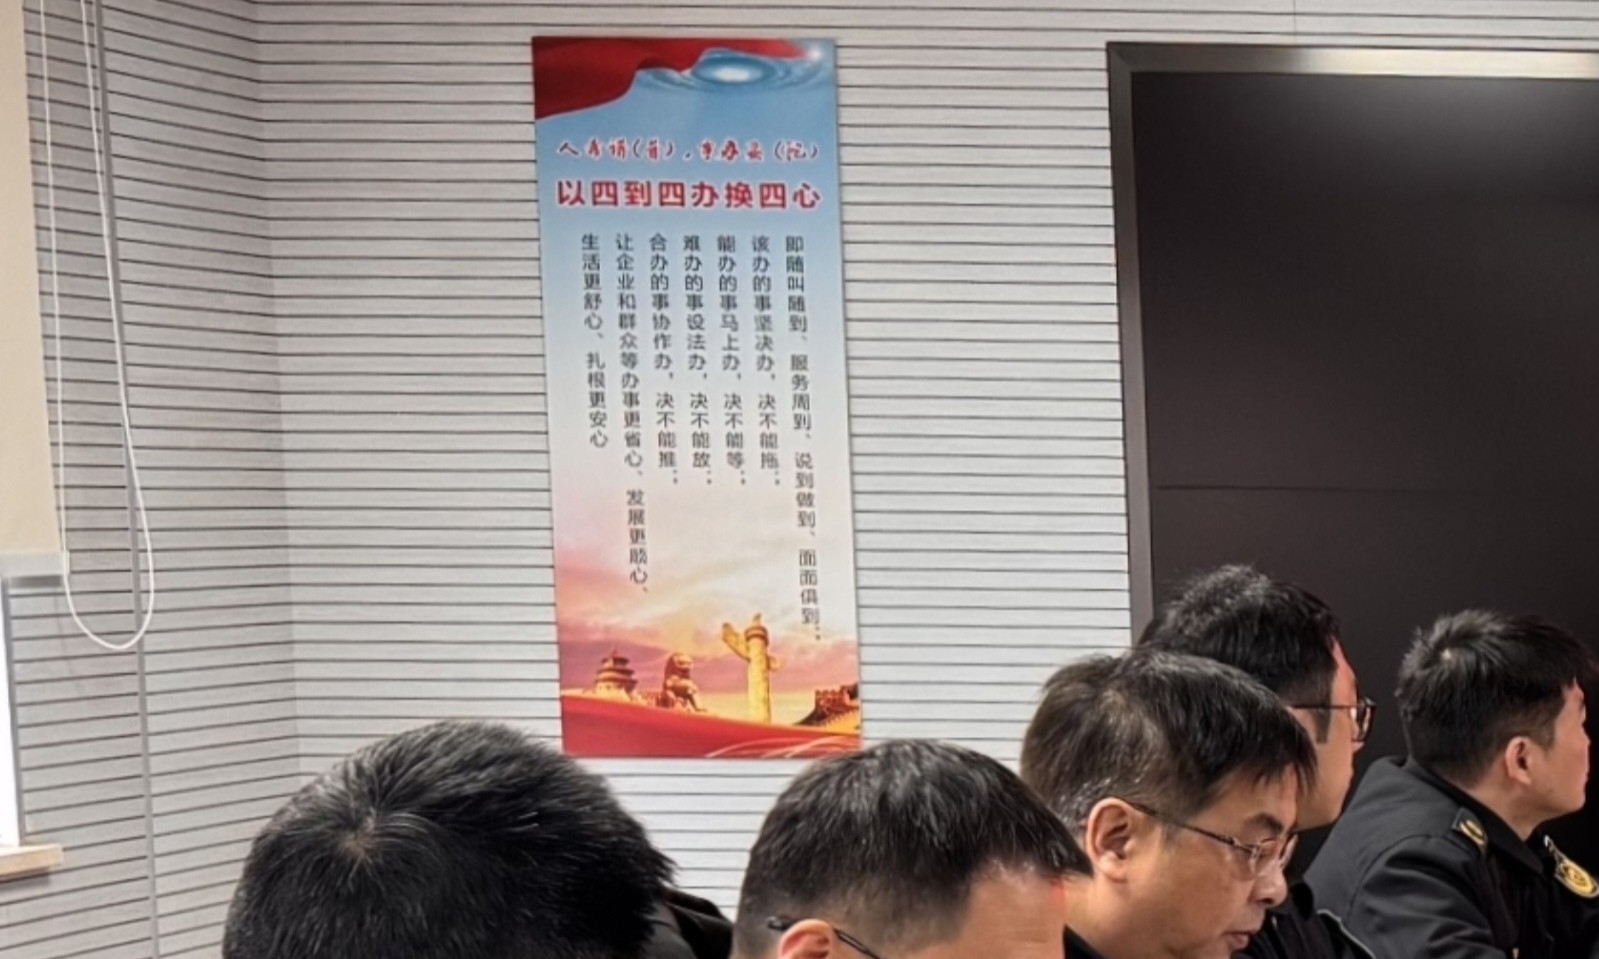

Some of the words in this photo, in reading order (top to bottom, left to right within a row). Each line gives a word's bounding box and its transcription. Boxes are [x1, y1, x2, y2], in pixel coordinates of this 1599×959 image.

[557, 179, 821, 209] 以四到四办换四心
